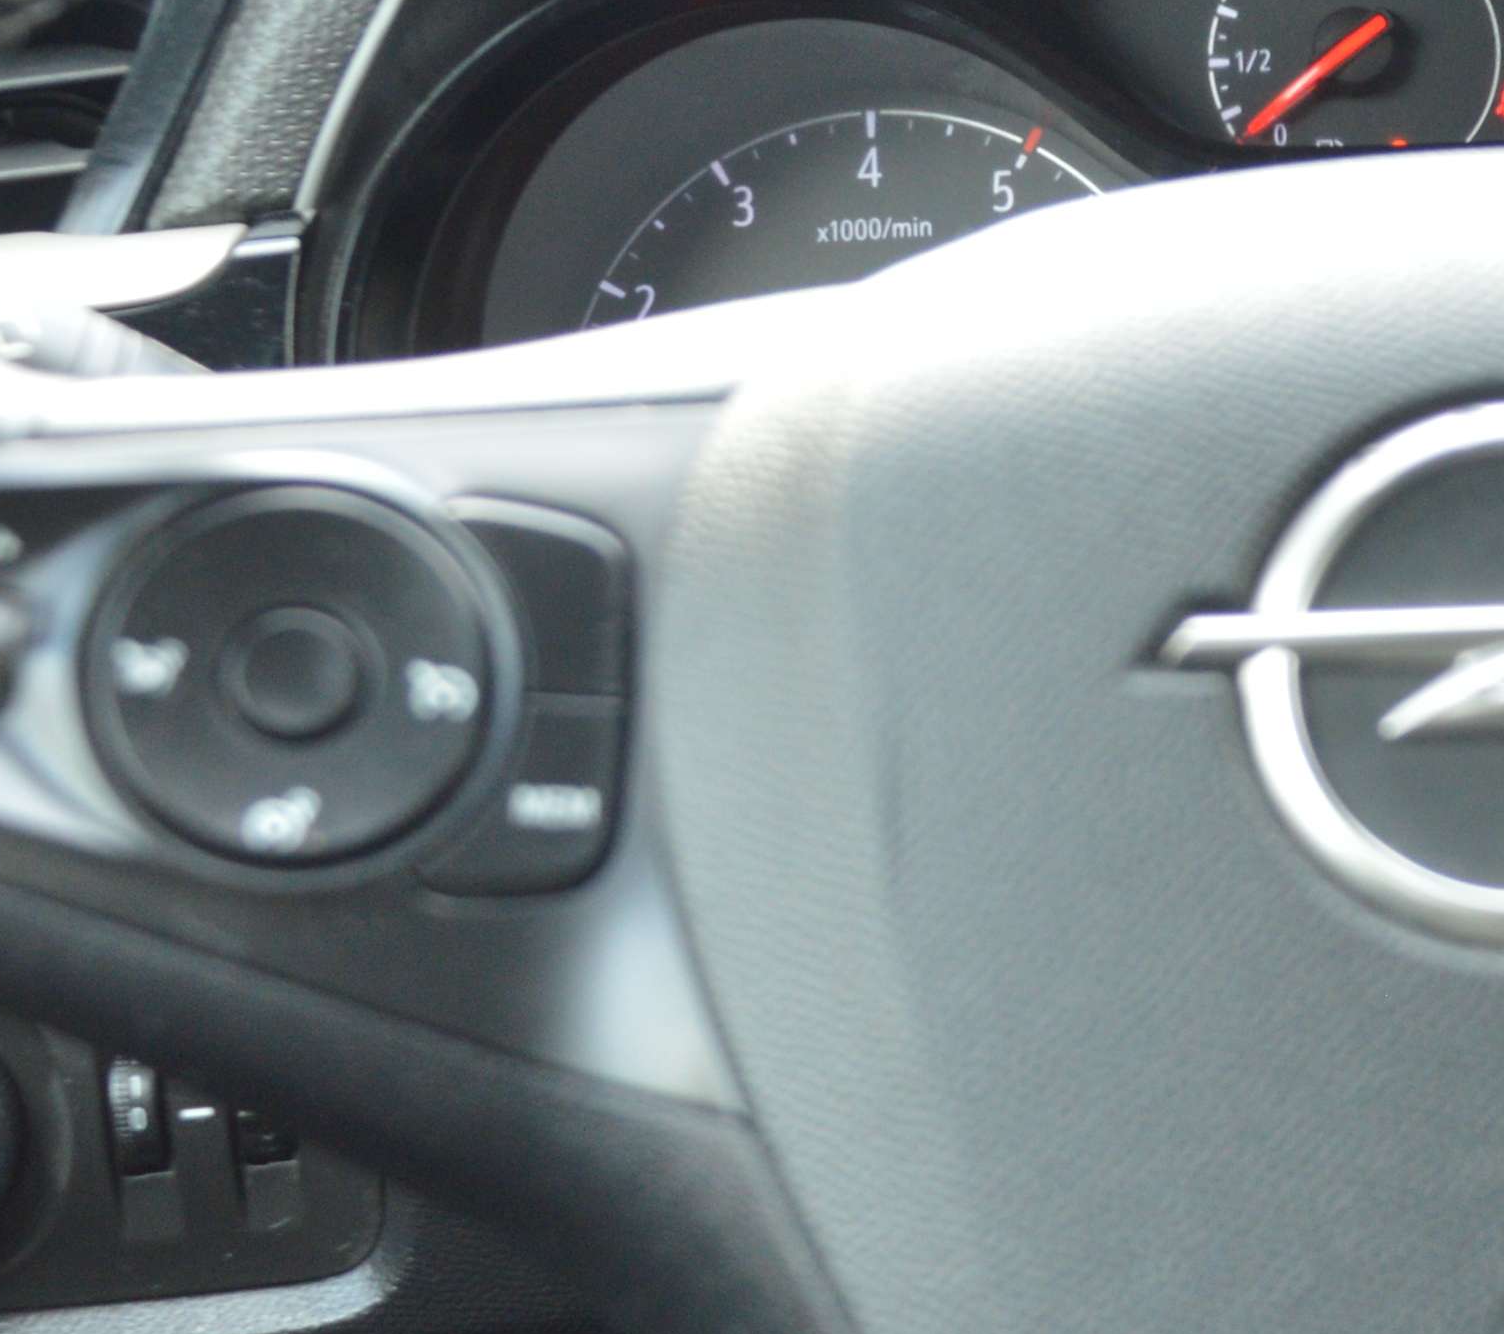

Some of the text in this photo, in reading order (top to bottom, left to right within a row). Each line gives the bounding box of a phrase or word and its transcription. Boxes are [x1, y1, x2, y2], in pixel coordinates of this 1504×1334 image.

[1235, 49, 1272, 74] 1/2
[1273, 123, 1288, 147] 0
[855, 146, 883, 189] 4
[731, 184, 757, 229] 3
[991, 172, 1014, 212] 5
[816, 217, 933, 243] x1000/min
